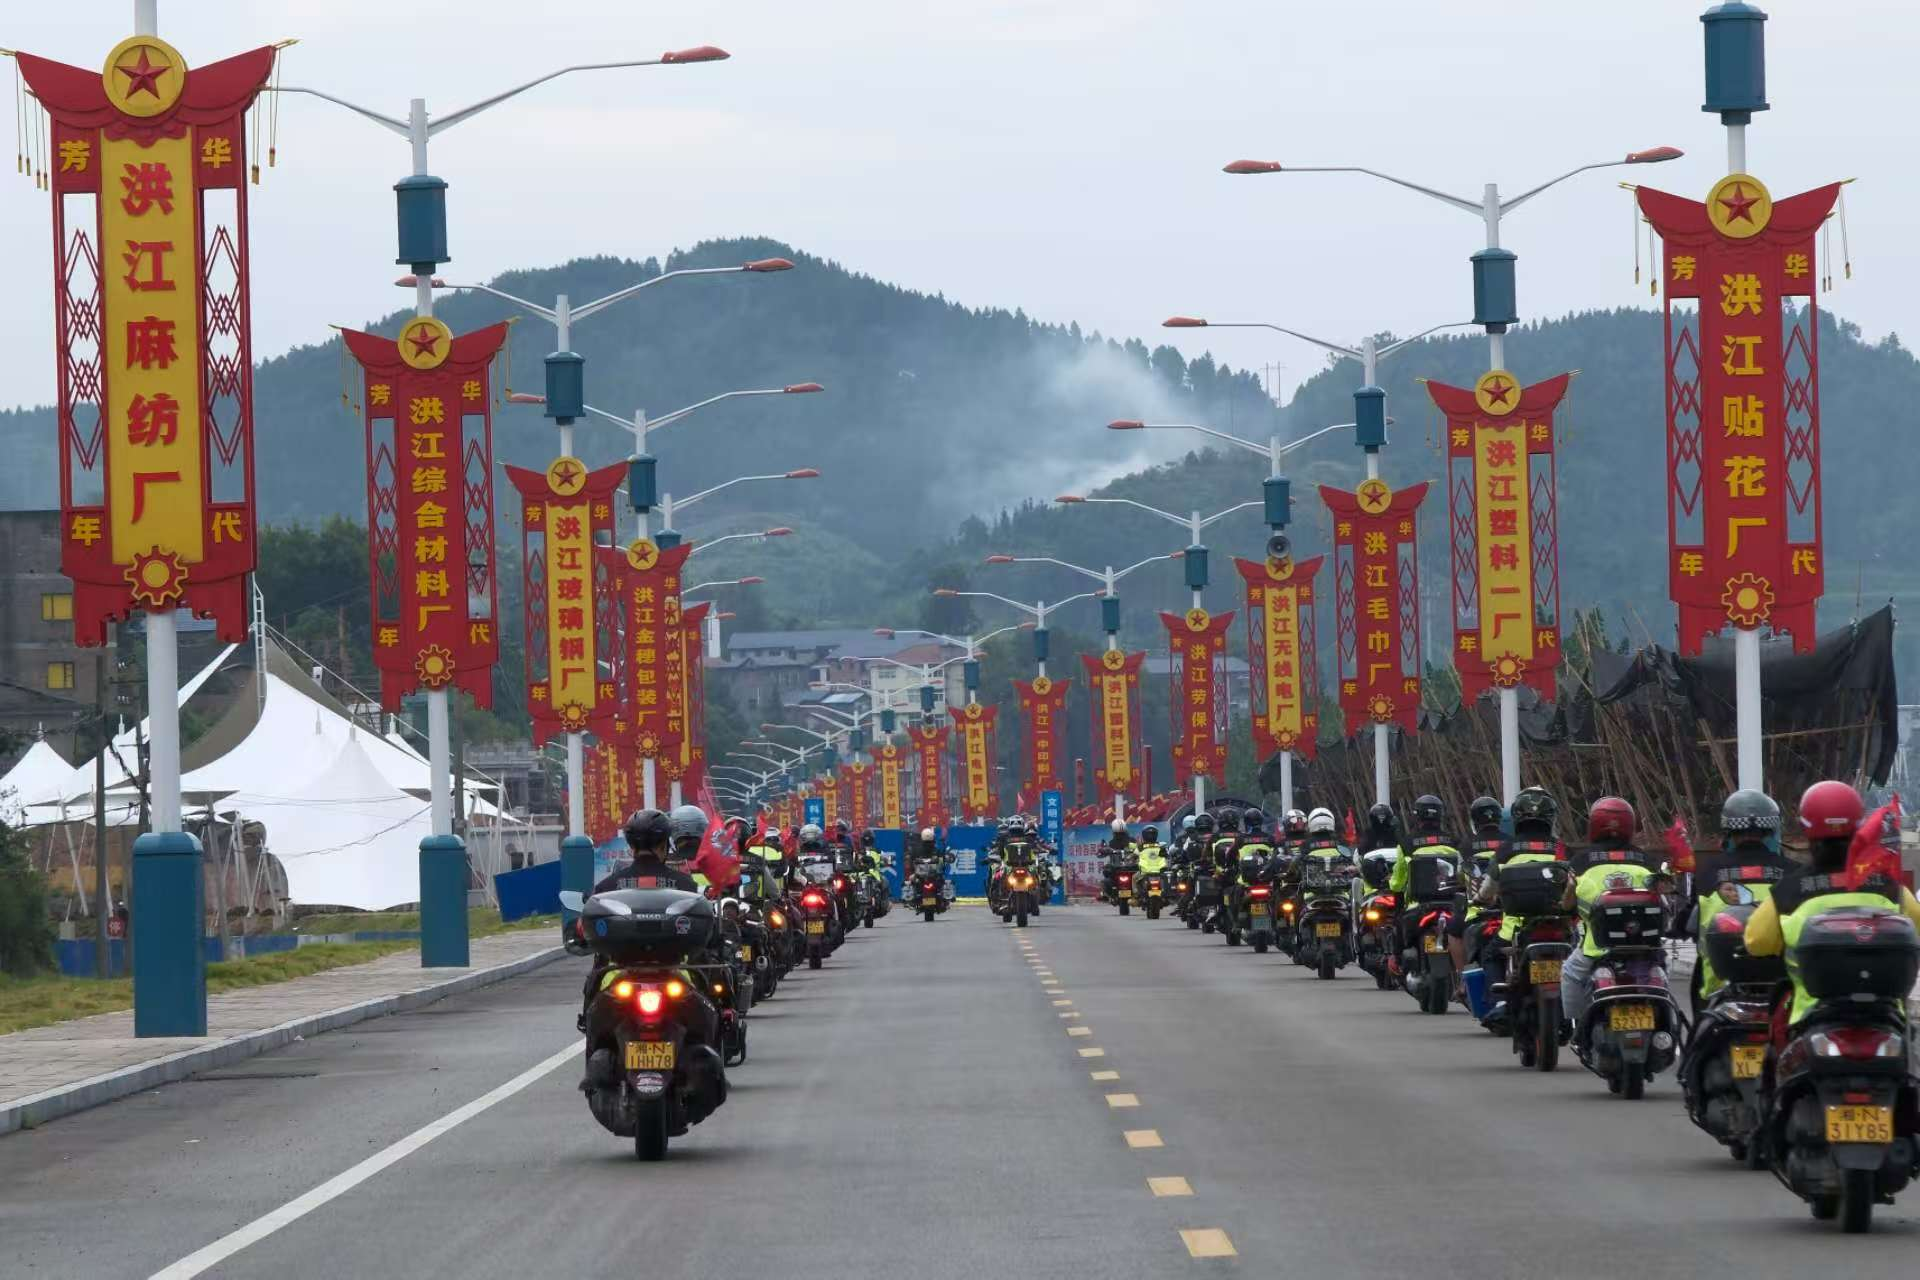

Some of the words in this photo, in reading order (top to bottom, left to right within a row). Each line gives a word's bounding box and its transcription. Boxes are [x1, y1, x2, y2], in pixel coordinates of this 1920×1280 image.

[59, 139, 90, 172] 芳
[201, 137, 232, 169] 华
[1671, 255, 1697, 281] 芳
[1783, 253, 1809, 279] 华
[119, 162, 182, 525] 洪江麻纺厂
[370, 383, 391, 405] 芳
[461, 380, 482, 401] 华
[1719, 273, 1768, 559] 洪江贴花厂
[1451, 428, 1470, 447] 芳
[1531, 424, 1549, 442] 华
[71, 515, 102, 546] 年
[211, 511, 243, 543] 代
[409, 397, 451, 632] 洪江综合材料厂
[526, 506, 542, 522] 芳
[593, 504, 609, 521] 华
[1337, 522, 1352, 537] 芳
[1399, 521, 1412, 536] 华
[1486, 439, 1522, 640] 洪江塑料一厂
[1679, 552, 1704, 577] 年
[1791, 549, 1816, 575] 代
[554, 516, 586, 691] 洪江玻璃钢厂
[1363, 531, 1392, 686] 洪江毛巾厂
[379, 627, 399, 648] 年
[470, 623, 490, 645] 代
[1459, 635, 1477, 653] 年
[1537, 630, 1556, 649] 代
[1271, 594, 1297, 723] 洪江无线电厂
[531, 686, 547, 702] 年
[599, 683, 615, 700] 代
[1190, 643, 1208, 749] 洪江劳保厂
[1343, 682, 1357, 696] 年
[1403, 679, 1418, 695] 代
